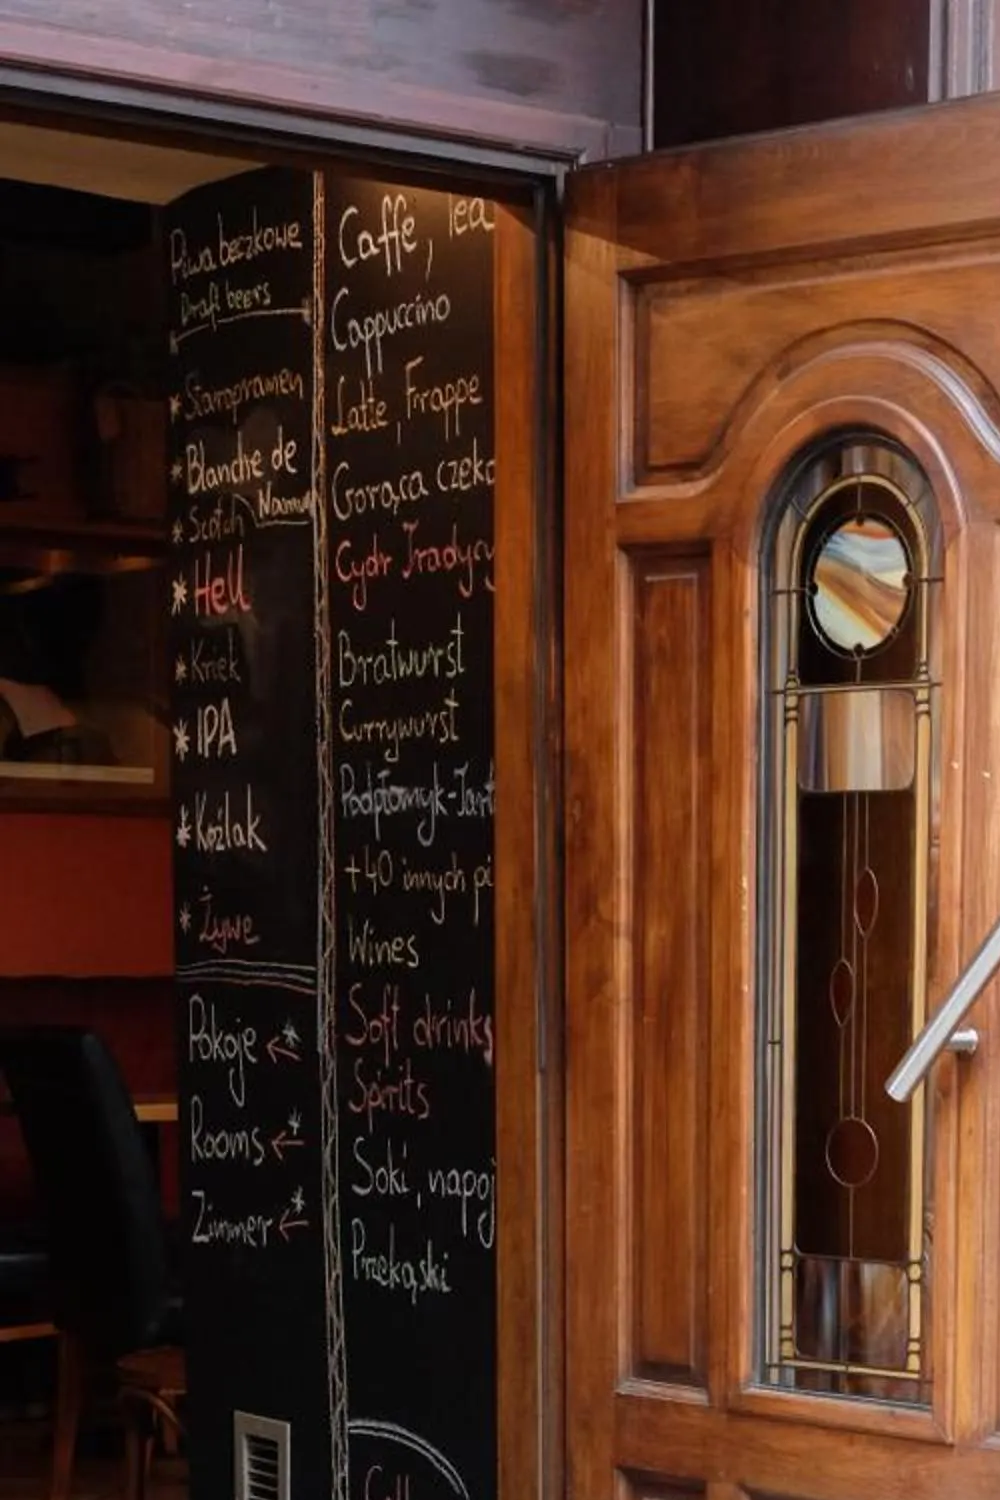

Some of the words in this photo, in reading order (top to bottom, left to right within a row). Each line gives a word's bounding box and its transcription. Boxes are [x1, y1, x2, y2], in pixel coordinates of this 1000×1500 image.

[226, 279, 271, 310] beers
[331, 287, 450, 379] Cappuccino
[271, 424, 297, 474] de
[194, 544, 252, 616] Hell
[336, 533, 393, 610] Cydr
[338, 612, 464, 687] Bratwurst
[196, 696, 237, 759] IPA
[339, 688, 459, 762] Currywurst
[344, 844, 393, 895] +40
[348, 915, 420, 968] Wines
[189, 992, 258, 1108] Pokoje
[345, 982, 399, 1067] Soft
[413, 988, 494, 1066] drinks
[190, 1095, 266, 1166] Rooms
[191, 1189, 273, 1248] Zimmer
